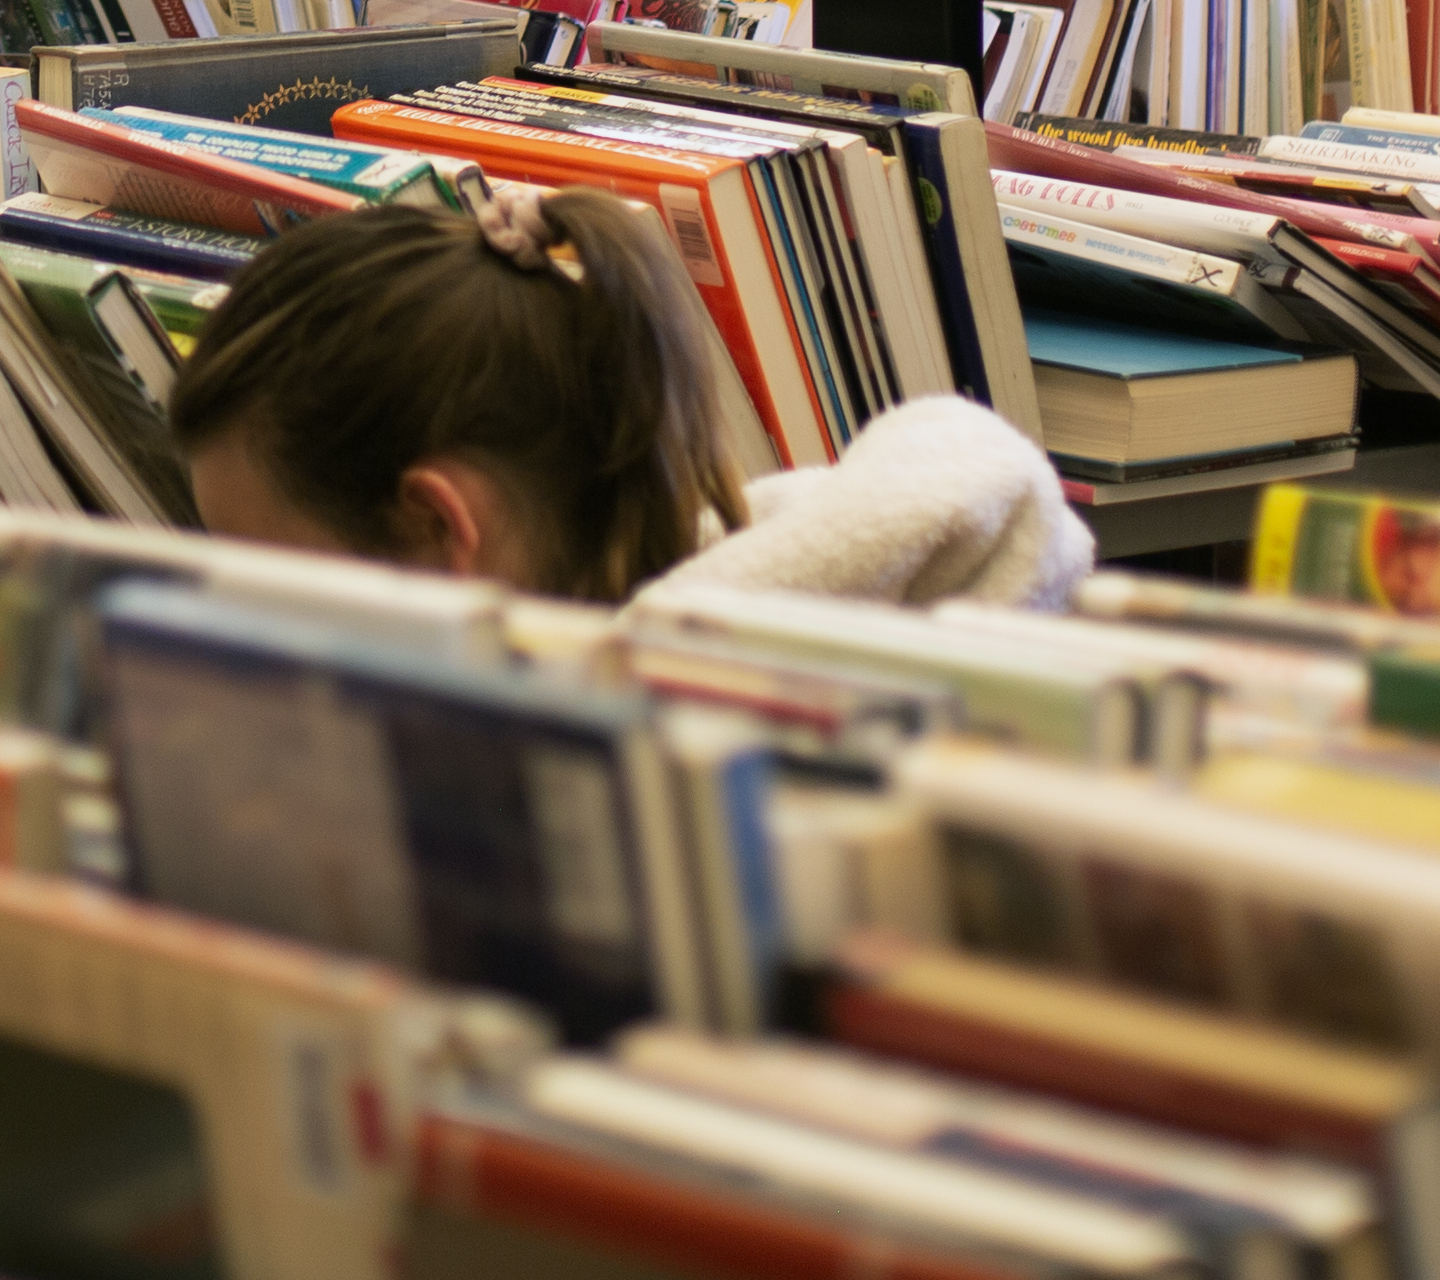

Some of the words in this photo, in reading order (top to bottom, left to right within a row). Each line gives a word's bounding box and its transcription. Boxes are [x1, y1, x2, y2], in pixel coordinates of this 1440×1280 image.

[393, 107, 456, 125] HOME
[45, 106, 107, 130] HOMESKILLS
[128, 131, 188, 156] WIRING
[1012, 129, 1057, 149] WAVERLY
[1037, 123, 1064, 140] the
[1067, 128, 1112, 147] wood
[1116, 131, 1144, 148] fire
[1367, 135, 1385, 143] THE
[185, 132, 207, 143] THE
[206, 134, 261, 151] COMPLETE
[260, 142, 299, 156] PHOTO
[298, 147, 334, 161] GUIDE
[333, 152, 351, 163] TO
[223, 146, 261, 161] HOME
[259, 151, 345, 172] IMPROVEMENT
[1283, 140, 1420, 169] SHIRTMAKING
[1039, 176, 1117, 212] DOLLS
[1177, 175, 1208, 192] pillows
